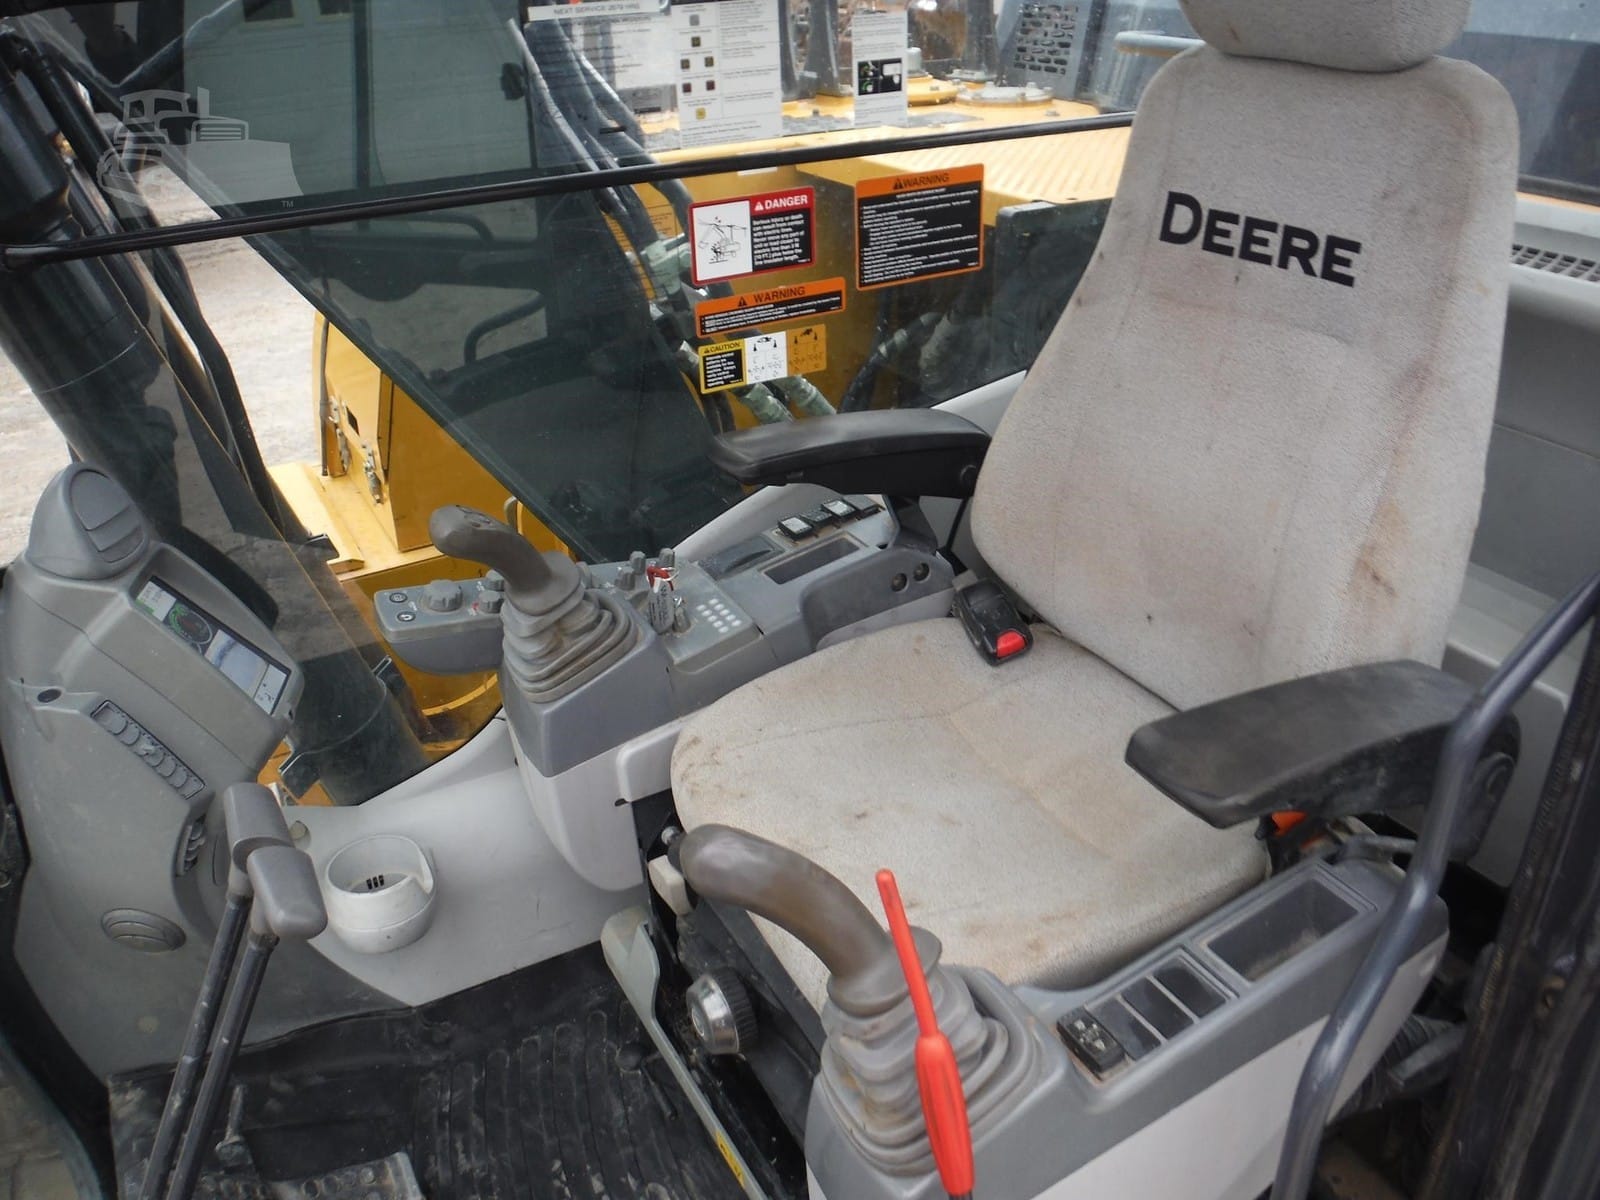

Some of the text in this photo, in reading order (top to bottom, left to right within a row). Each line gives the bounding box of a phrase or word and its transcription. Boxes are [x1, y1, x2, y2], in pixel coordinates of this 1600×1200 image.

[903, 173, 949, 190] WARNING
[765, 195, 808, 210] DANGER
[1158, 191, 1361, 288] DEERE
[754, 286, 806, 304] WARNING
[710, 342, 740, 354] CAUTION
